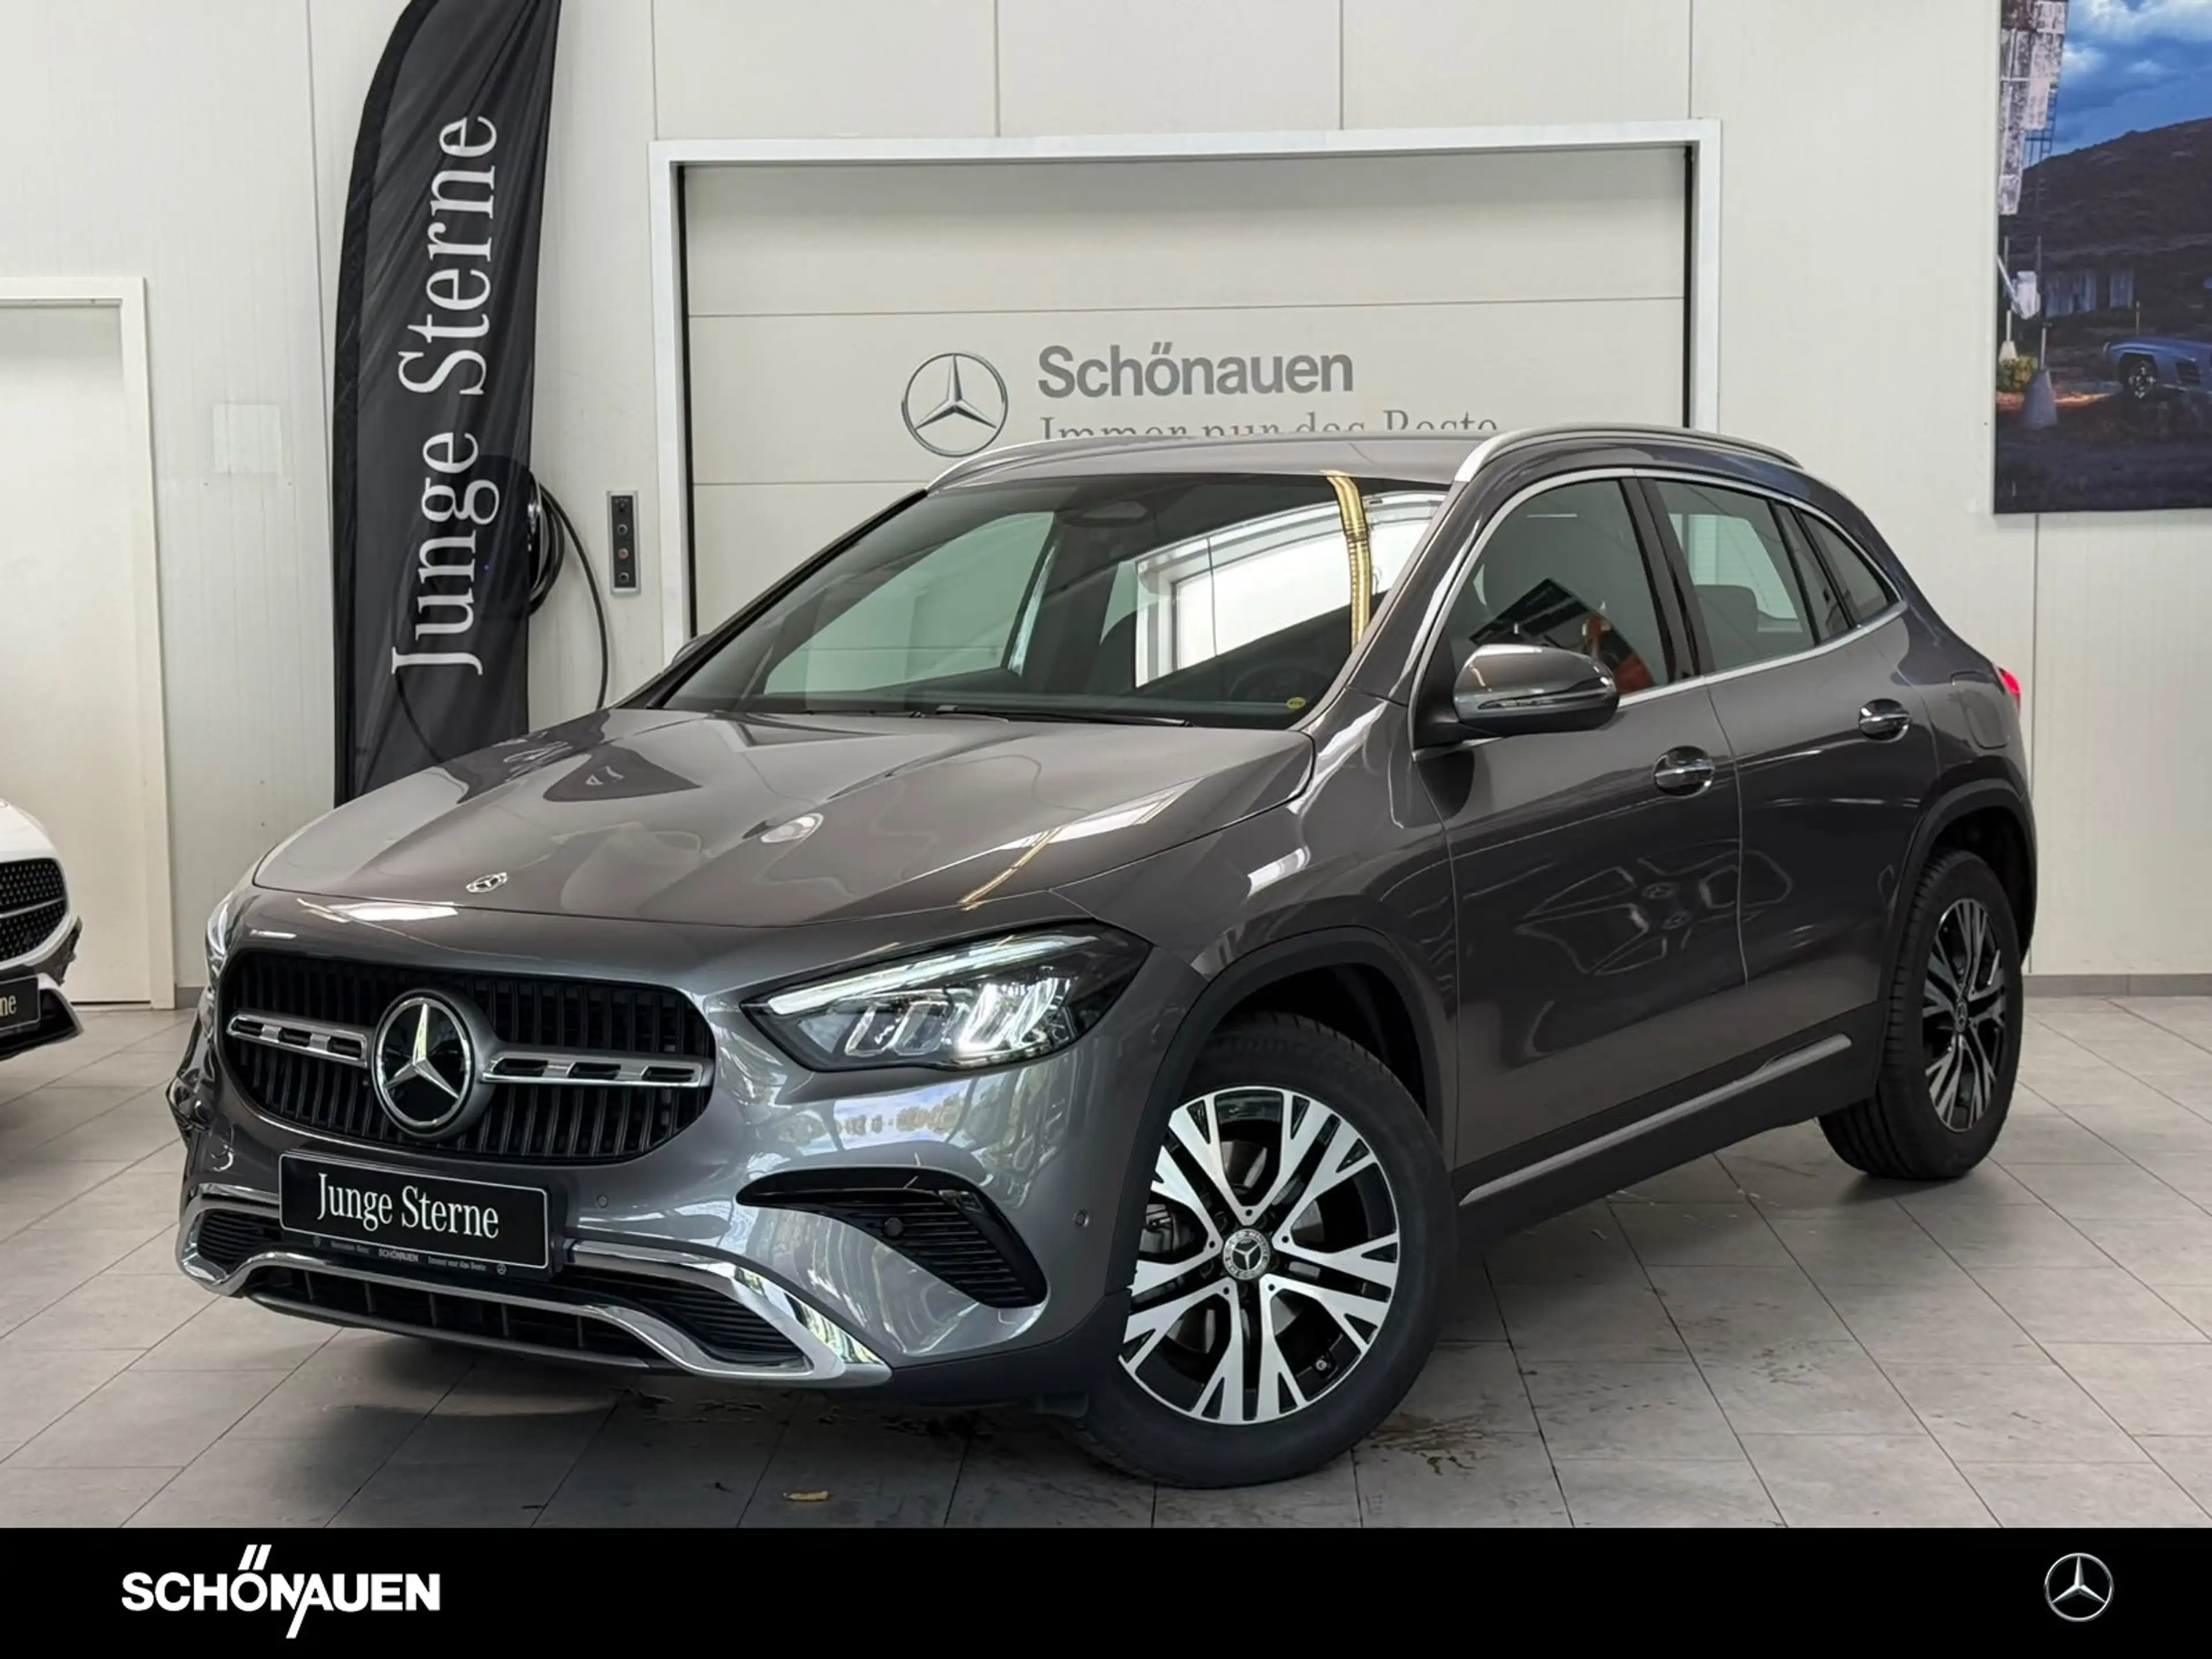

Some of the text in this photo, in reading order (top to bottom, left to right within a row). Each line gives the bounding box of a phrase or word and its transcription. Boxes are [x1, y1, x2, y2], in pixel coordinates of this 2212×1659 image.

[391, 116, 499, 675] Junge Sterne
[1038, 341, 1353, 399] Schönauen
[317, 1172, 499, 1238] Junge Sterne
